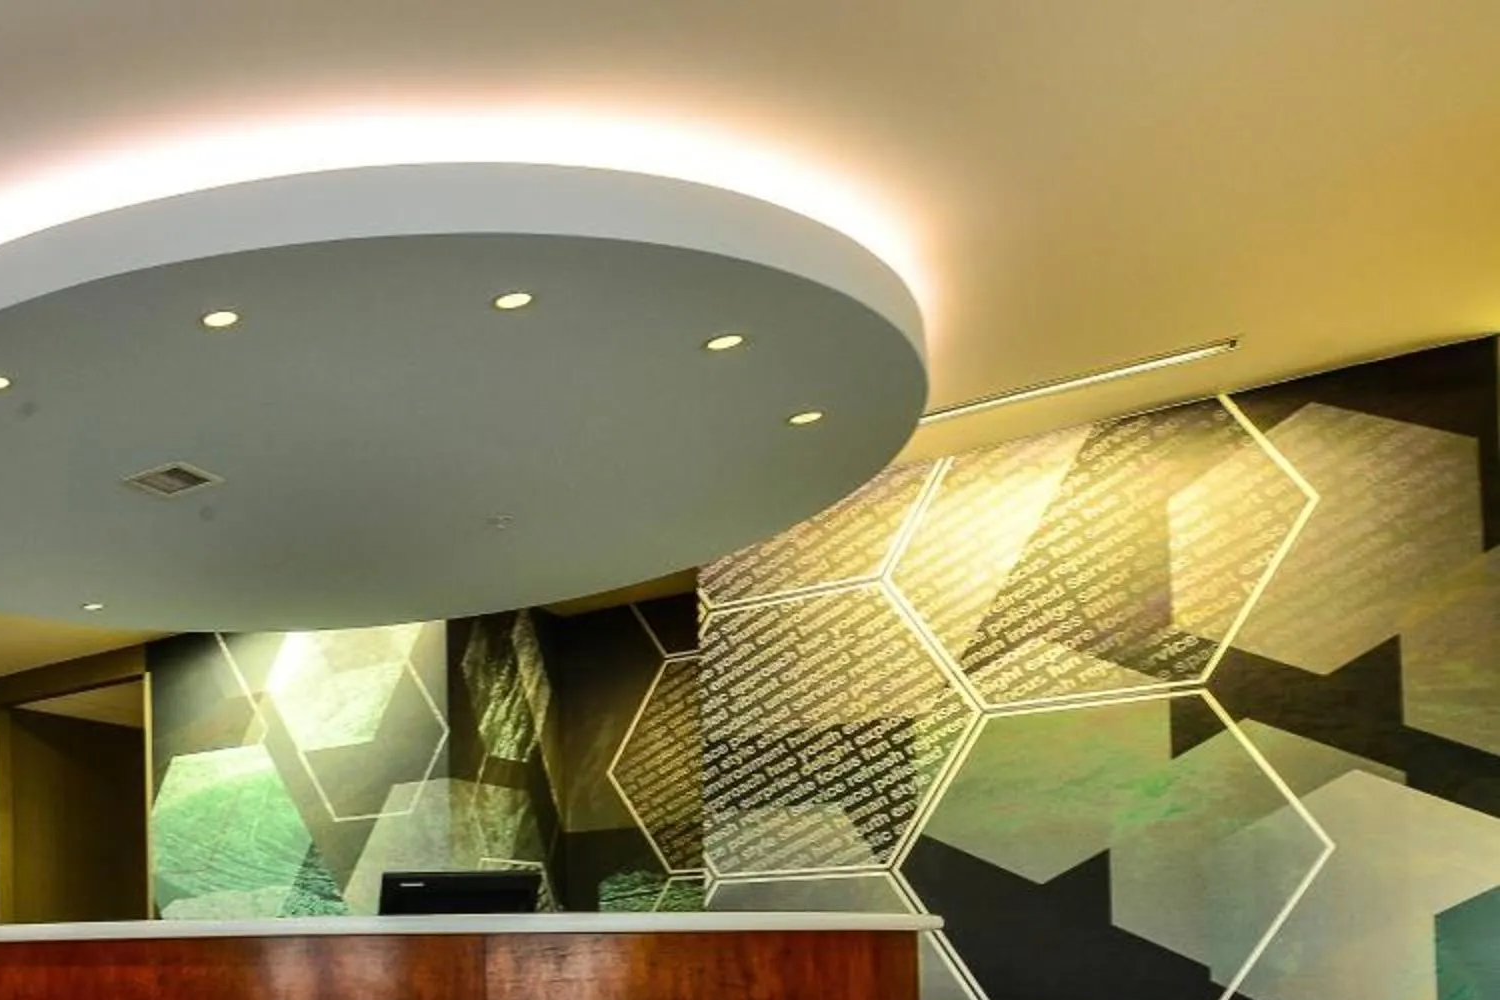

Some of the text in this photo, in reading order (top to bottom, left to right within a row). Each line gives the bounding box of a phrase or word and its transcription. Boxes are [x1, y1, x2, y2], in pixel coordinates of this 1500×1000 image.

[984, 581, 1066, 638] polished
[1063, 540, 1137, 593] service
[1002, 592, 1078, 648] indulge
[1075, 564, 1133, 606] savor
[1023, 624, 1096, 676] explore
[727, 703, 795, 750] polished
[791, 672, 851, 712] service
[754, 715, 803, 751] share
[786, 710, 842, 750] human
[738, 768, 802, 813] surprise
[798, 738, 857, 780] delight
[766, 752, 799, 779] hue
[795, 727, 845, 764] youth
[815, 752, 863, 787] focus
[860, 735, 893, 762] fun
[845, 746, 907, 790] refresh
